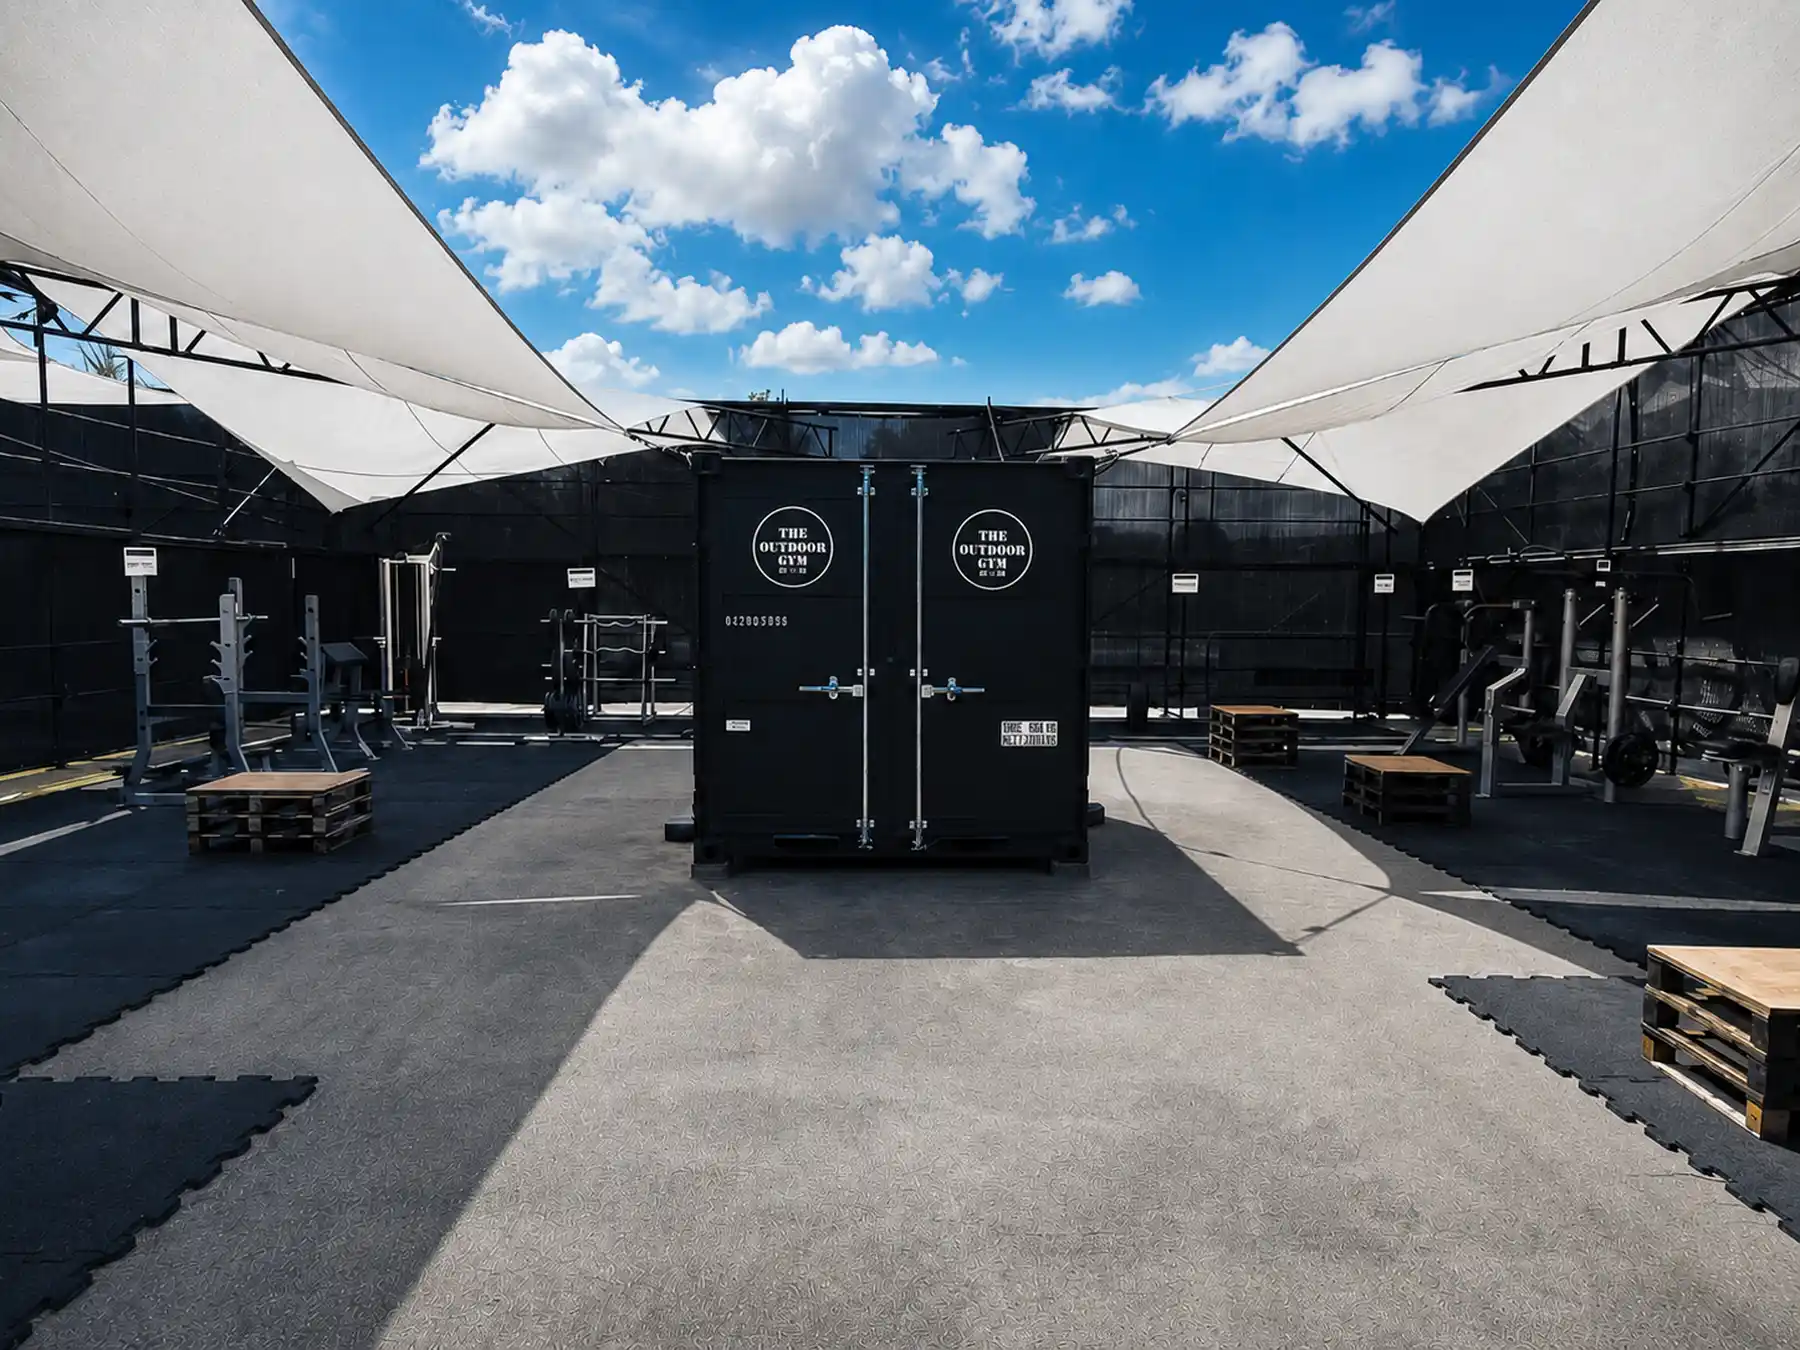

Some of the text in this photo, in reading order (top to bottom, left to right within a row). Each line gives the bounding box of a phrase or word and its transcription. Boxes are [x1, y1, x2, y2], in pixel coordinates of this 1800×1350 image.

[778, 527, 808, 539] THE
[978, 530, 1008, 541] THE
[759, 541, 827, 553] OUTDOOR
[959, 544, 1026, 556] OUTDOOR
[778, 555, 808, 566] GYM
[977, 557, 1007, 569] GYM
